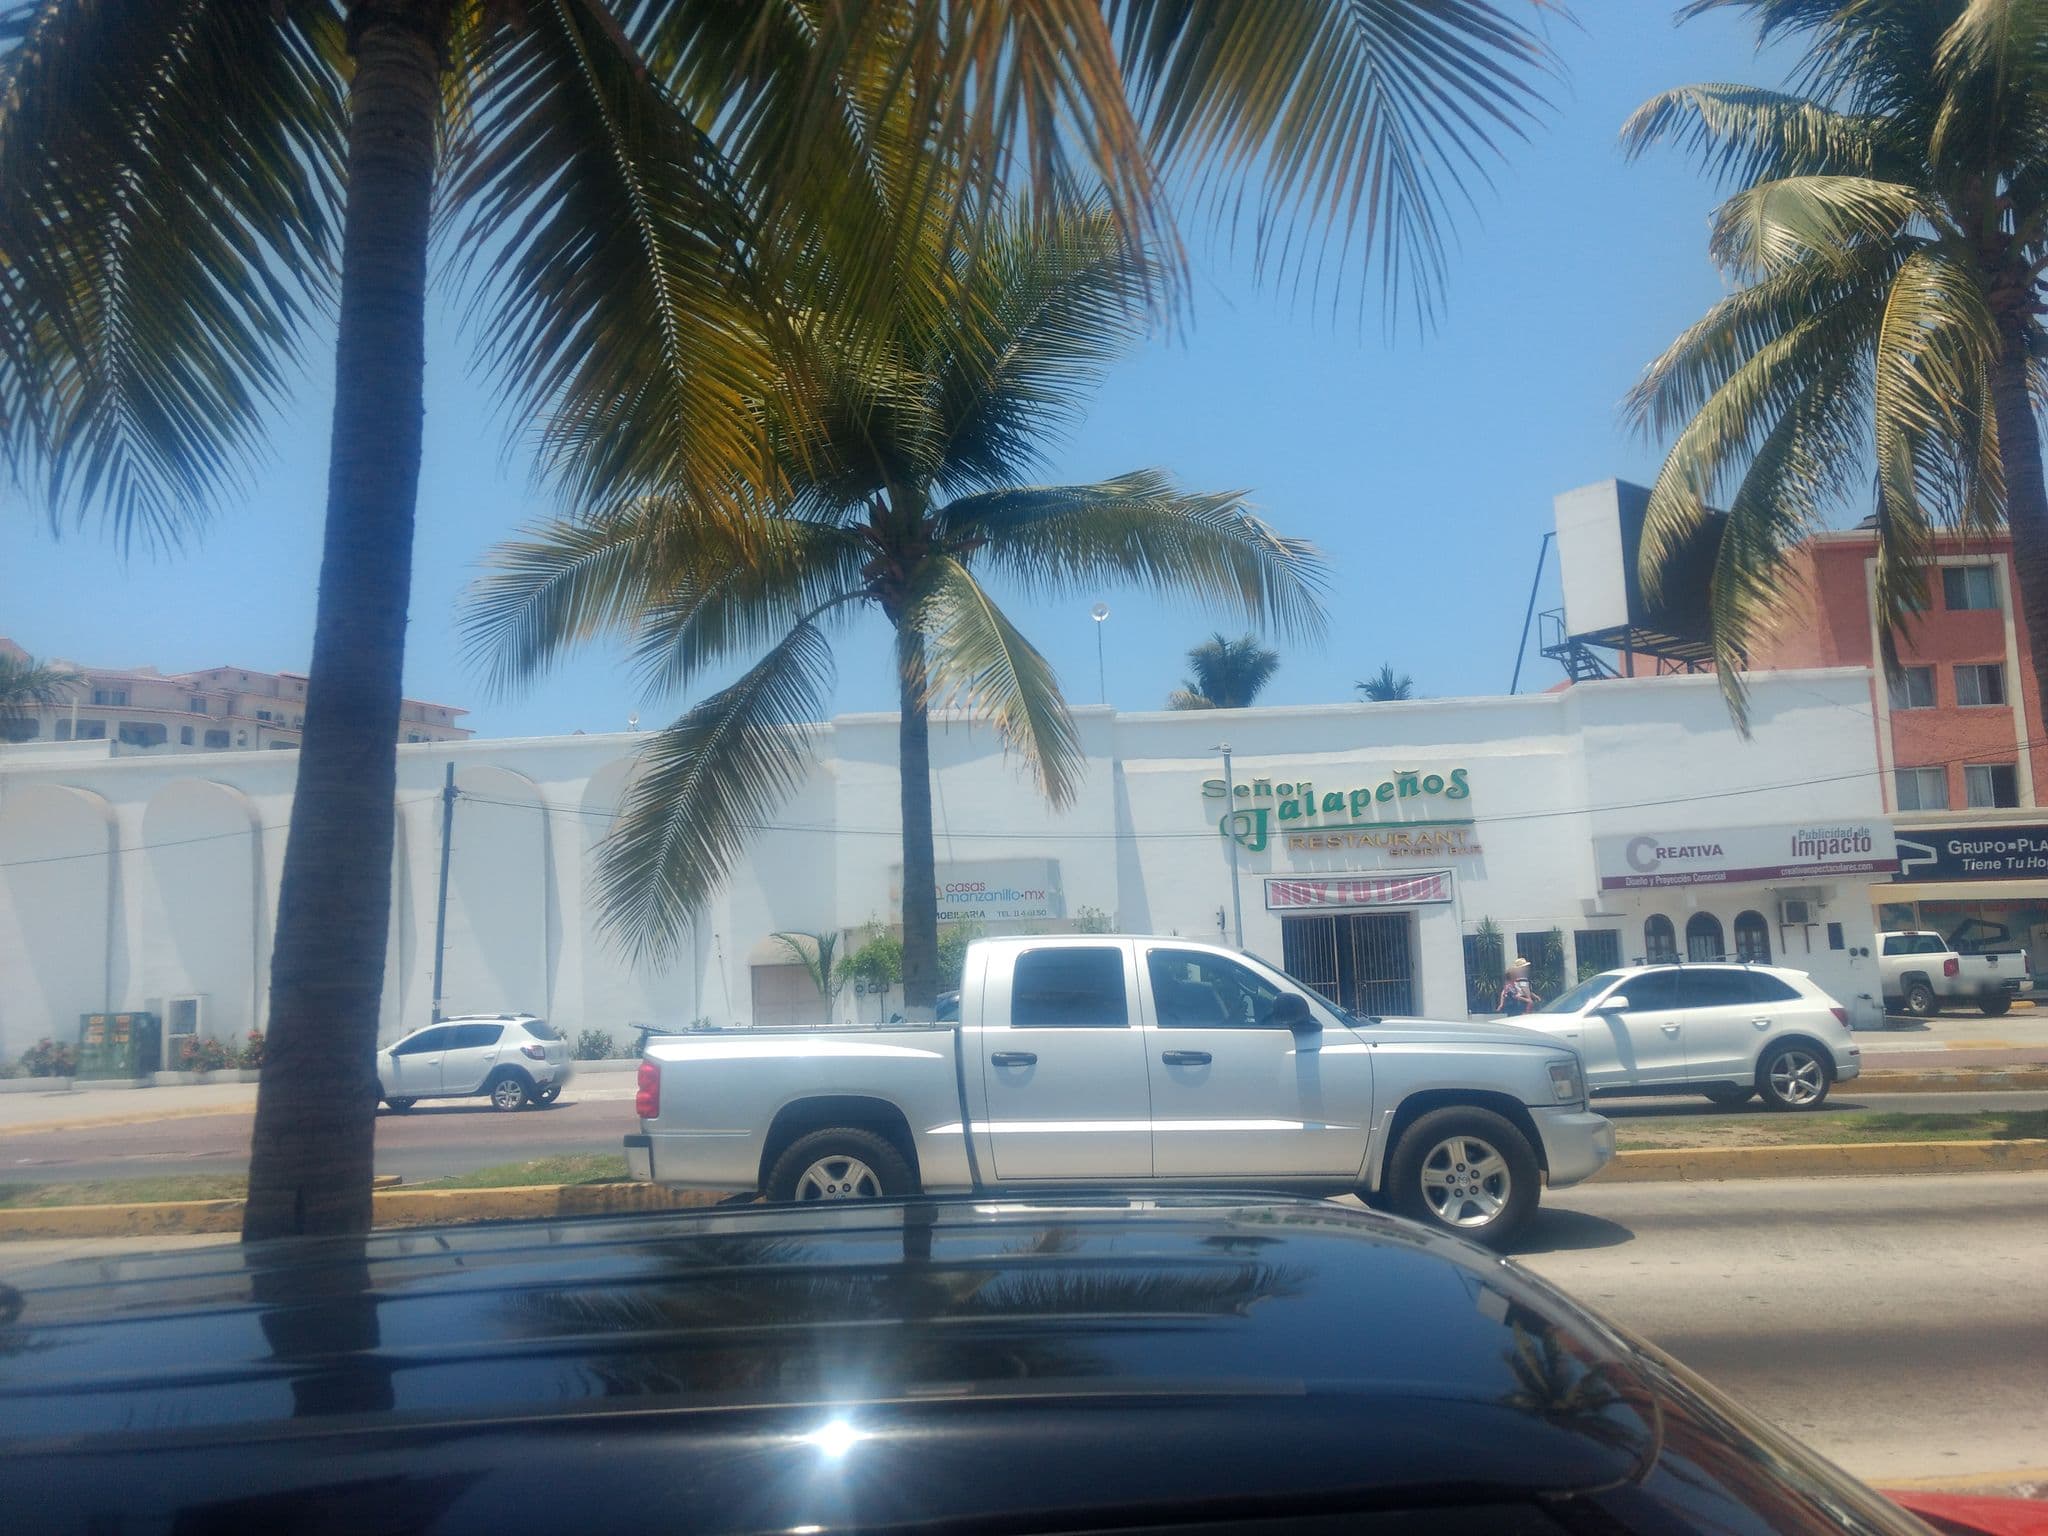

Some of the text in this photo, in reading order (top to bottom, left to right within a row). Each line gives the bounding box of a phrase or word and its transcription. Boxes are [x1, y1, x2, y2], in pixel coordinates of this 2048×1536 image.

[1202, 777, 1312, 798] Señor
[1288, 831, 1471, 851] RESTAURANT
[1799, 826, 1870, 840] Publicidad de
[1626, 836, 1724, 873] CREATIVA
[1791, 832, 1872, 860] Impacto
[1948, 839, 2007, 855] GRUPO
[1962, 855, 2048, 870] Tiene Tu Ho
[1692, 871, 1727, 882] Comercial
[945, 882, 986, 893] casas
[1271, 882, 1329, 906] HOY
